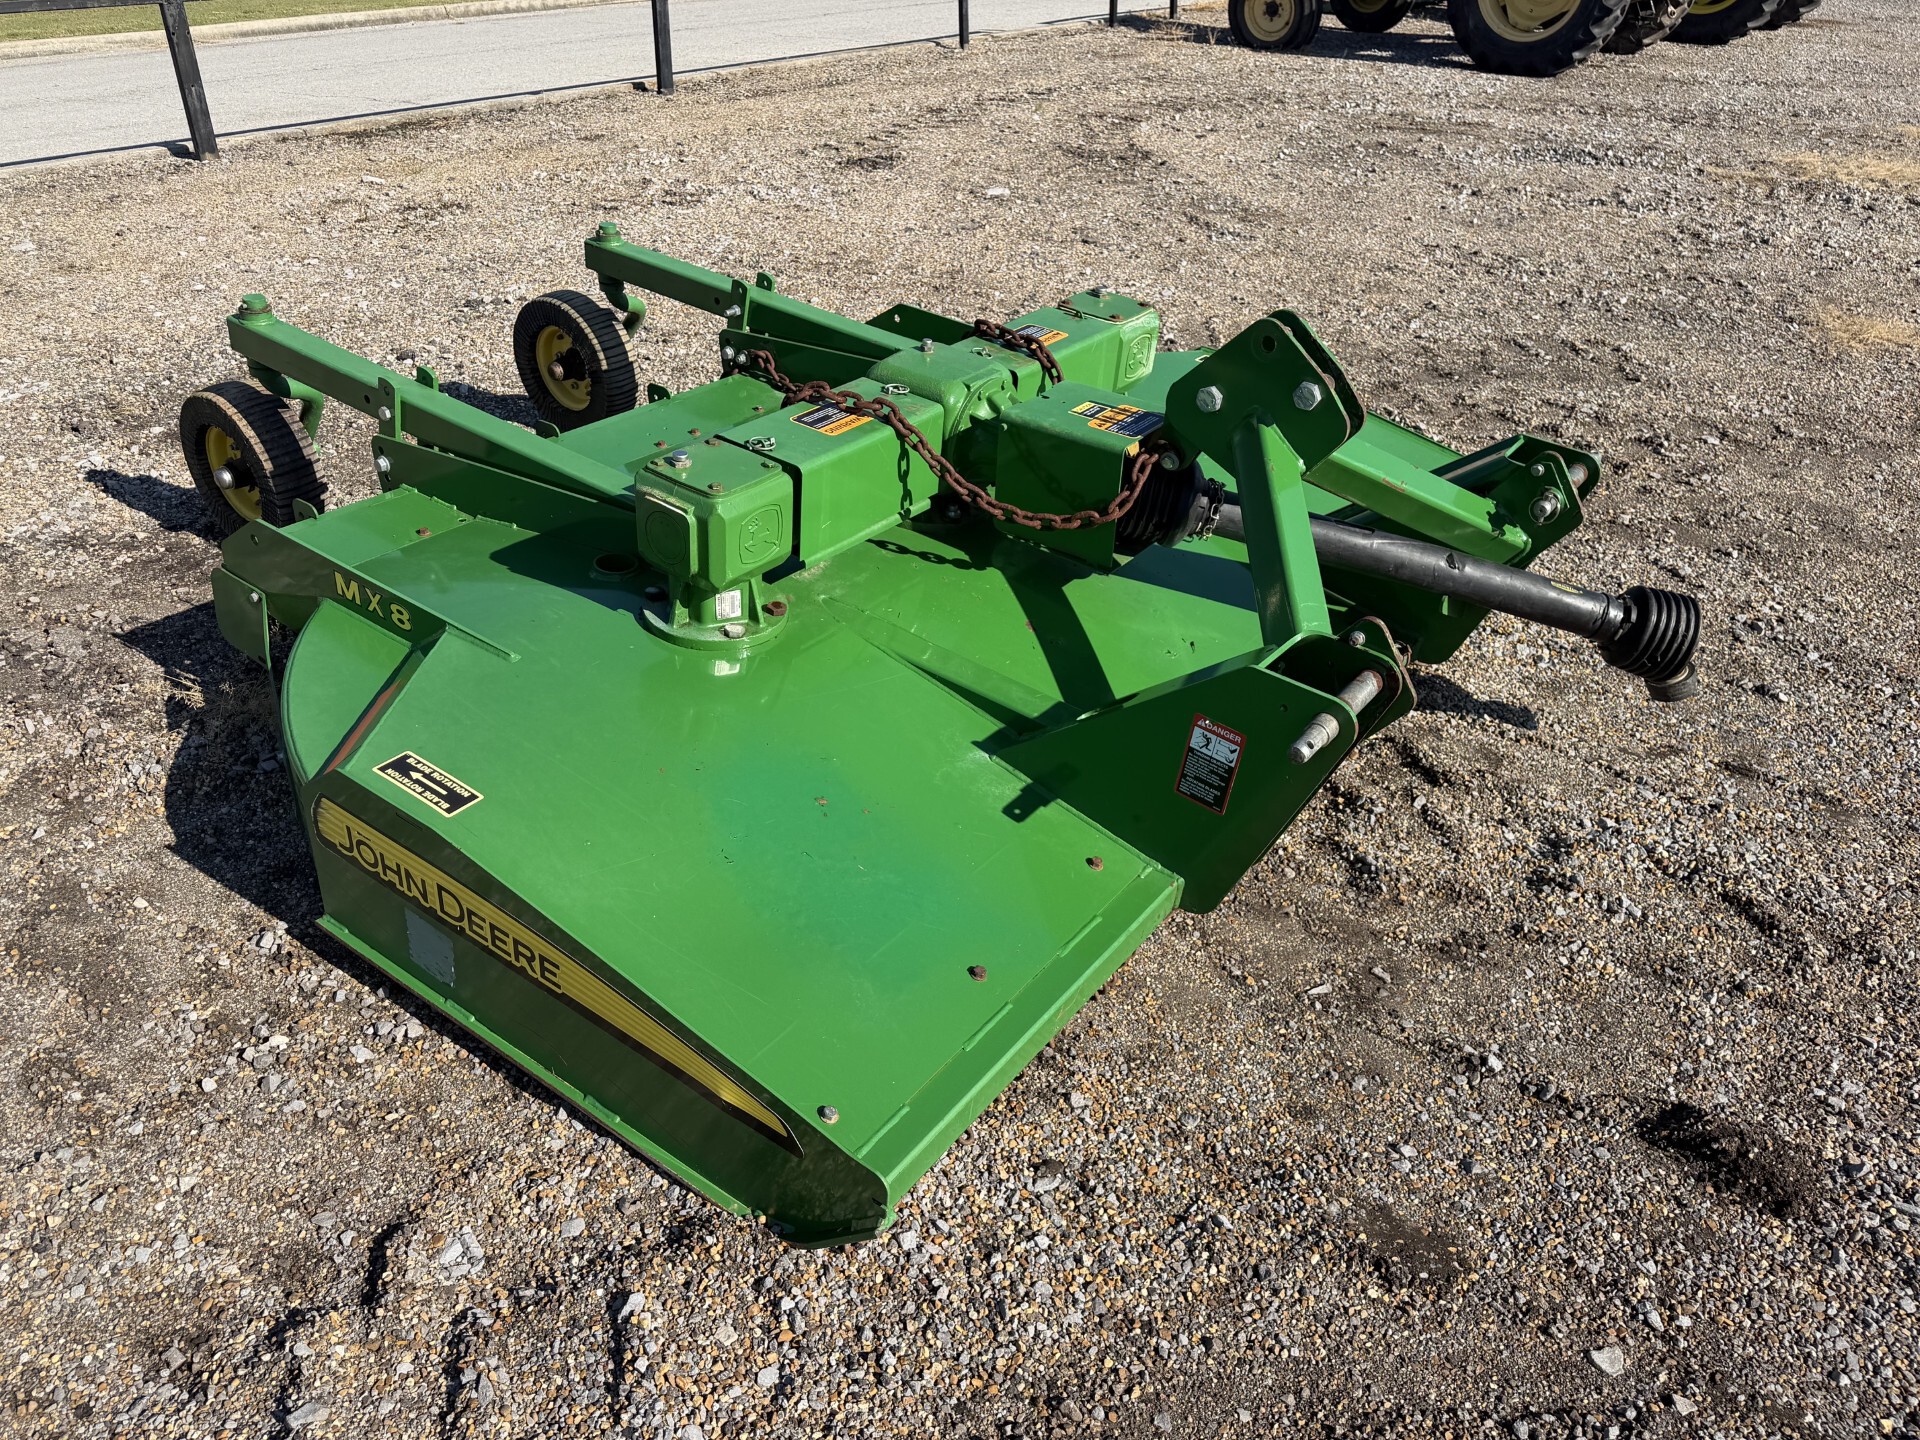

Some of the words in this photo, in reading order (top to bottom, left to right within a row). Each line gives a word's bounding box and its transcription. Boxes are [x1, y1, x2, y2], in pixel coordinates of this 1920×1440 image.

[1206, 722, 1242, 744] DANGER
[384, 768, 425, 793] ROTATION
[406, 757, 433, 775] BLADE
[430, 772, 471, 798] ROTATION
[422, 790, 451, 810] BLADE
[338, 824, 429, 905] JOHN
[436, 882, 562, 991] DEERE
